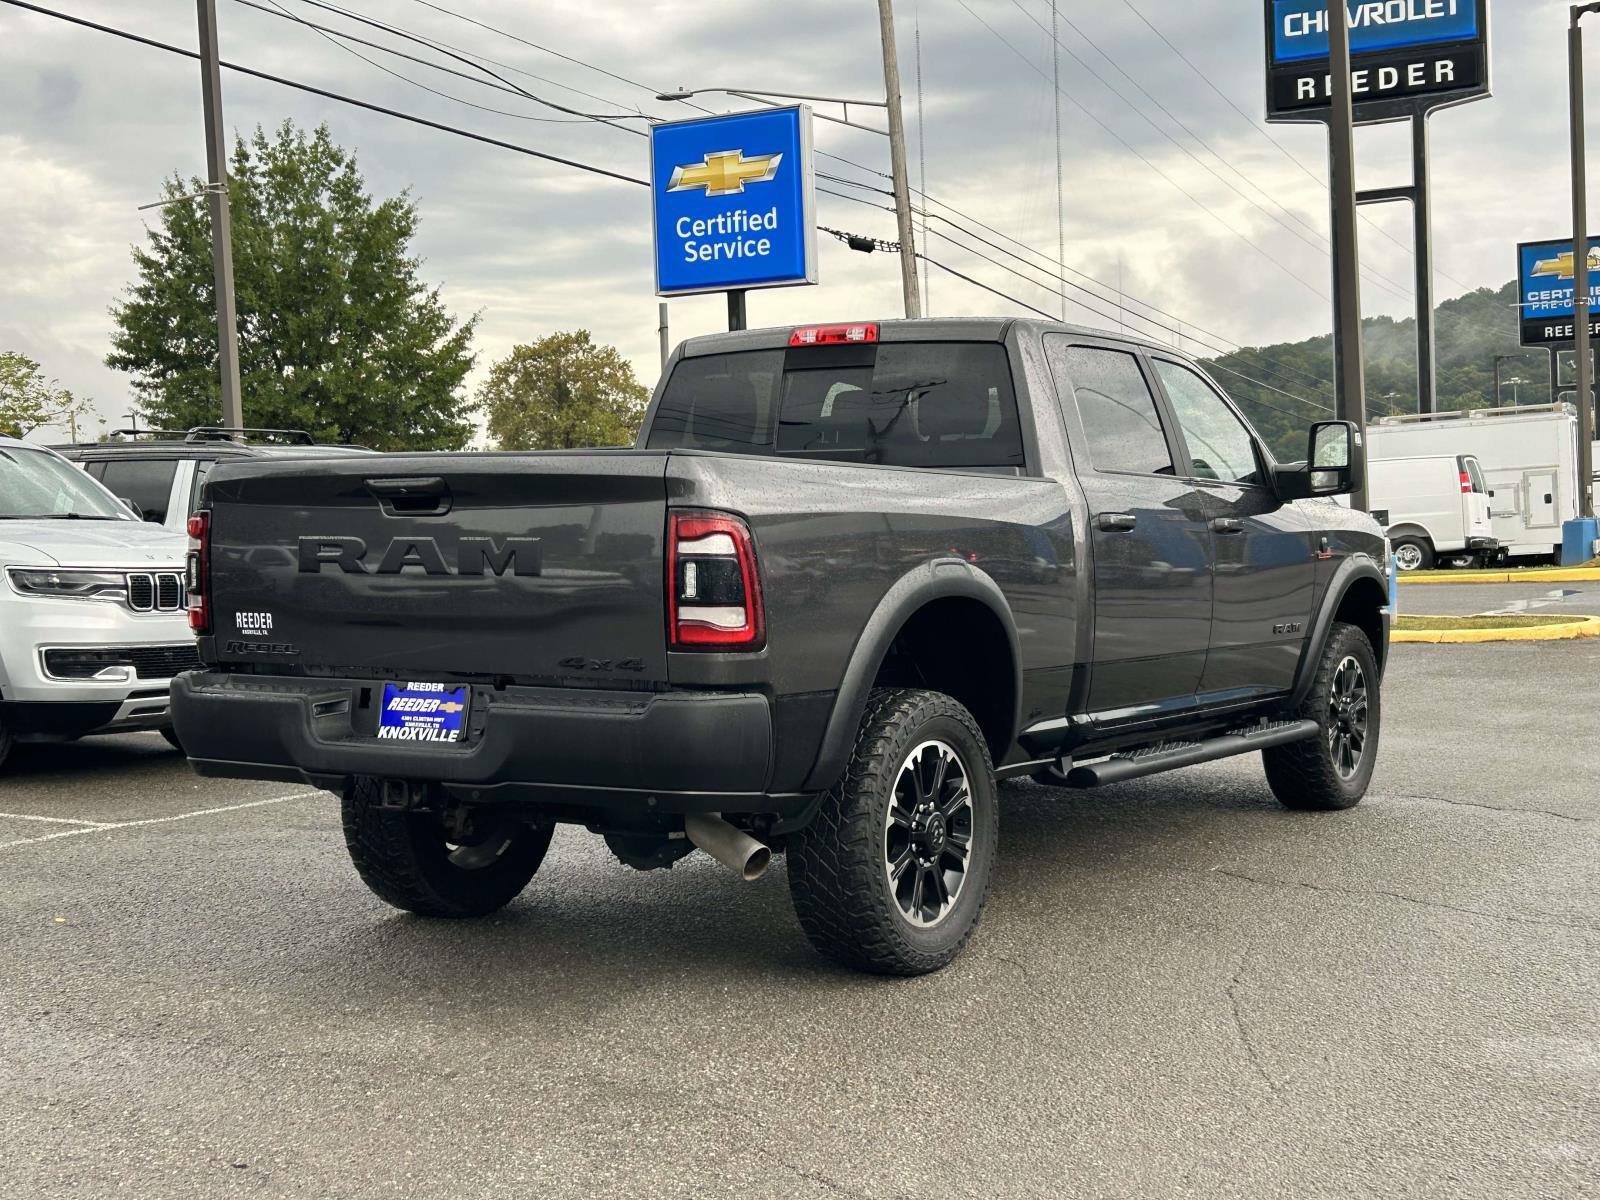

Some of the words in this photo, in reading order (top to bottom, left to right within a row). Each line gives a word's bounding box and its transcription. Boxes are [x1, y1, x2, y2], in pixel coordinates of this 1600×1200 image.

[1284, 0, 1457, 37] CHVROLET
[676, 206, 778, 238] Certified
[684, 236, 771, 263] Service
[298, 536, 542, 577] RAM
[235, 612, 273, 629] REEDER
[224, 640, 301, 656] REBEL
[407, 682, 445, 692] REEDER
[387, 697, 441, 713] REEDER
[378, 726, 460, 742] KNOXVILLE
